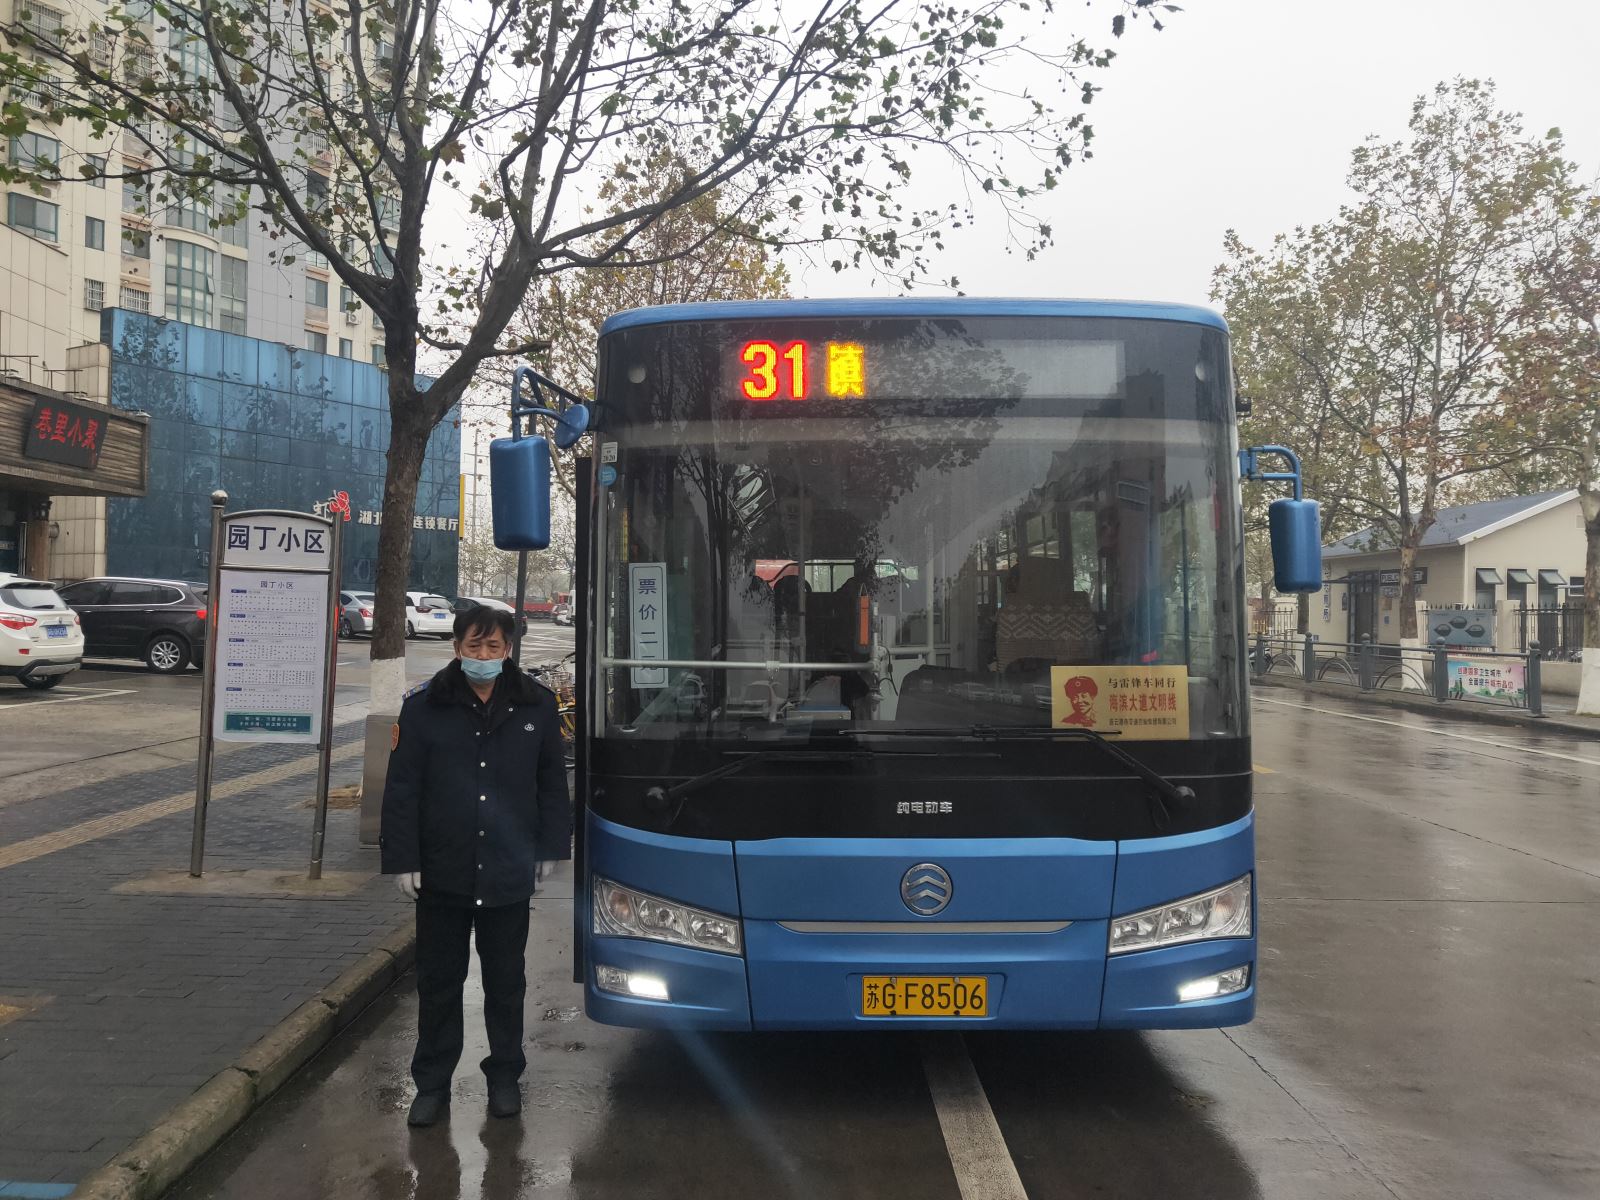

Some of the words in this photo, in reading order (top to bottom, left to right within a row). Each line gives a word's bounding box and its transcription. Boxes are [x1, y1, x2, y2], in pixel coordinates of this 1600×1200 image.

[743, 343, 803, 399] 31
[359, 509, 459, 531] 湖北连锁餐厅
[228, 525, 325, 554] 园丁小区
[261, 581, 294, 589] 园丁小区
[1108, 677, 1177, 689] 与雷锋车同行
[1109, 693, 1177, 712] 海滨大道文明线
[896, 801, 953, 814] 纯电动车
